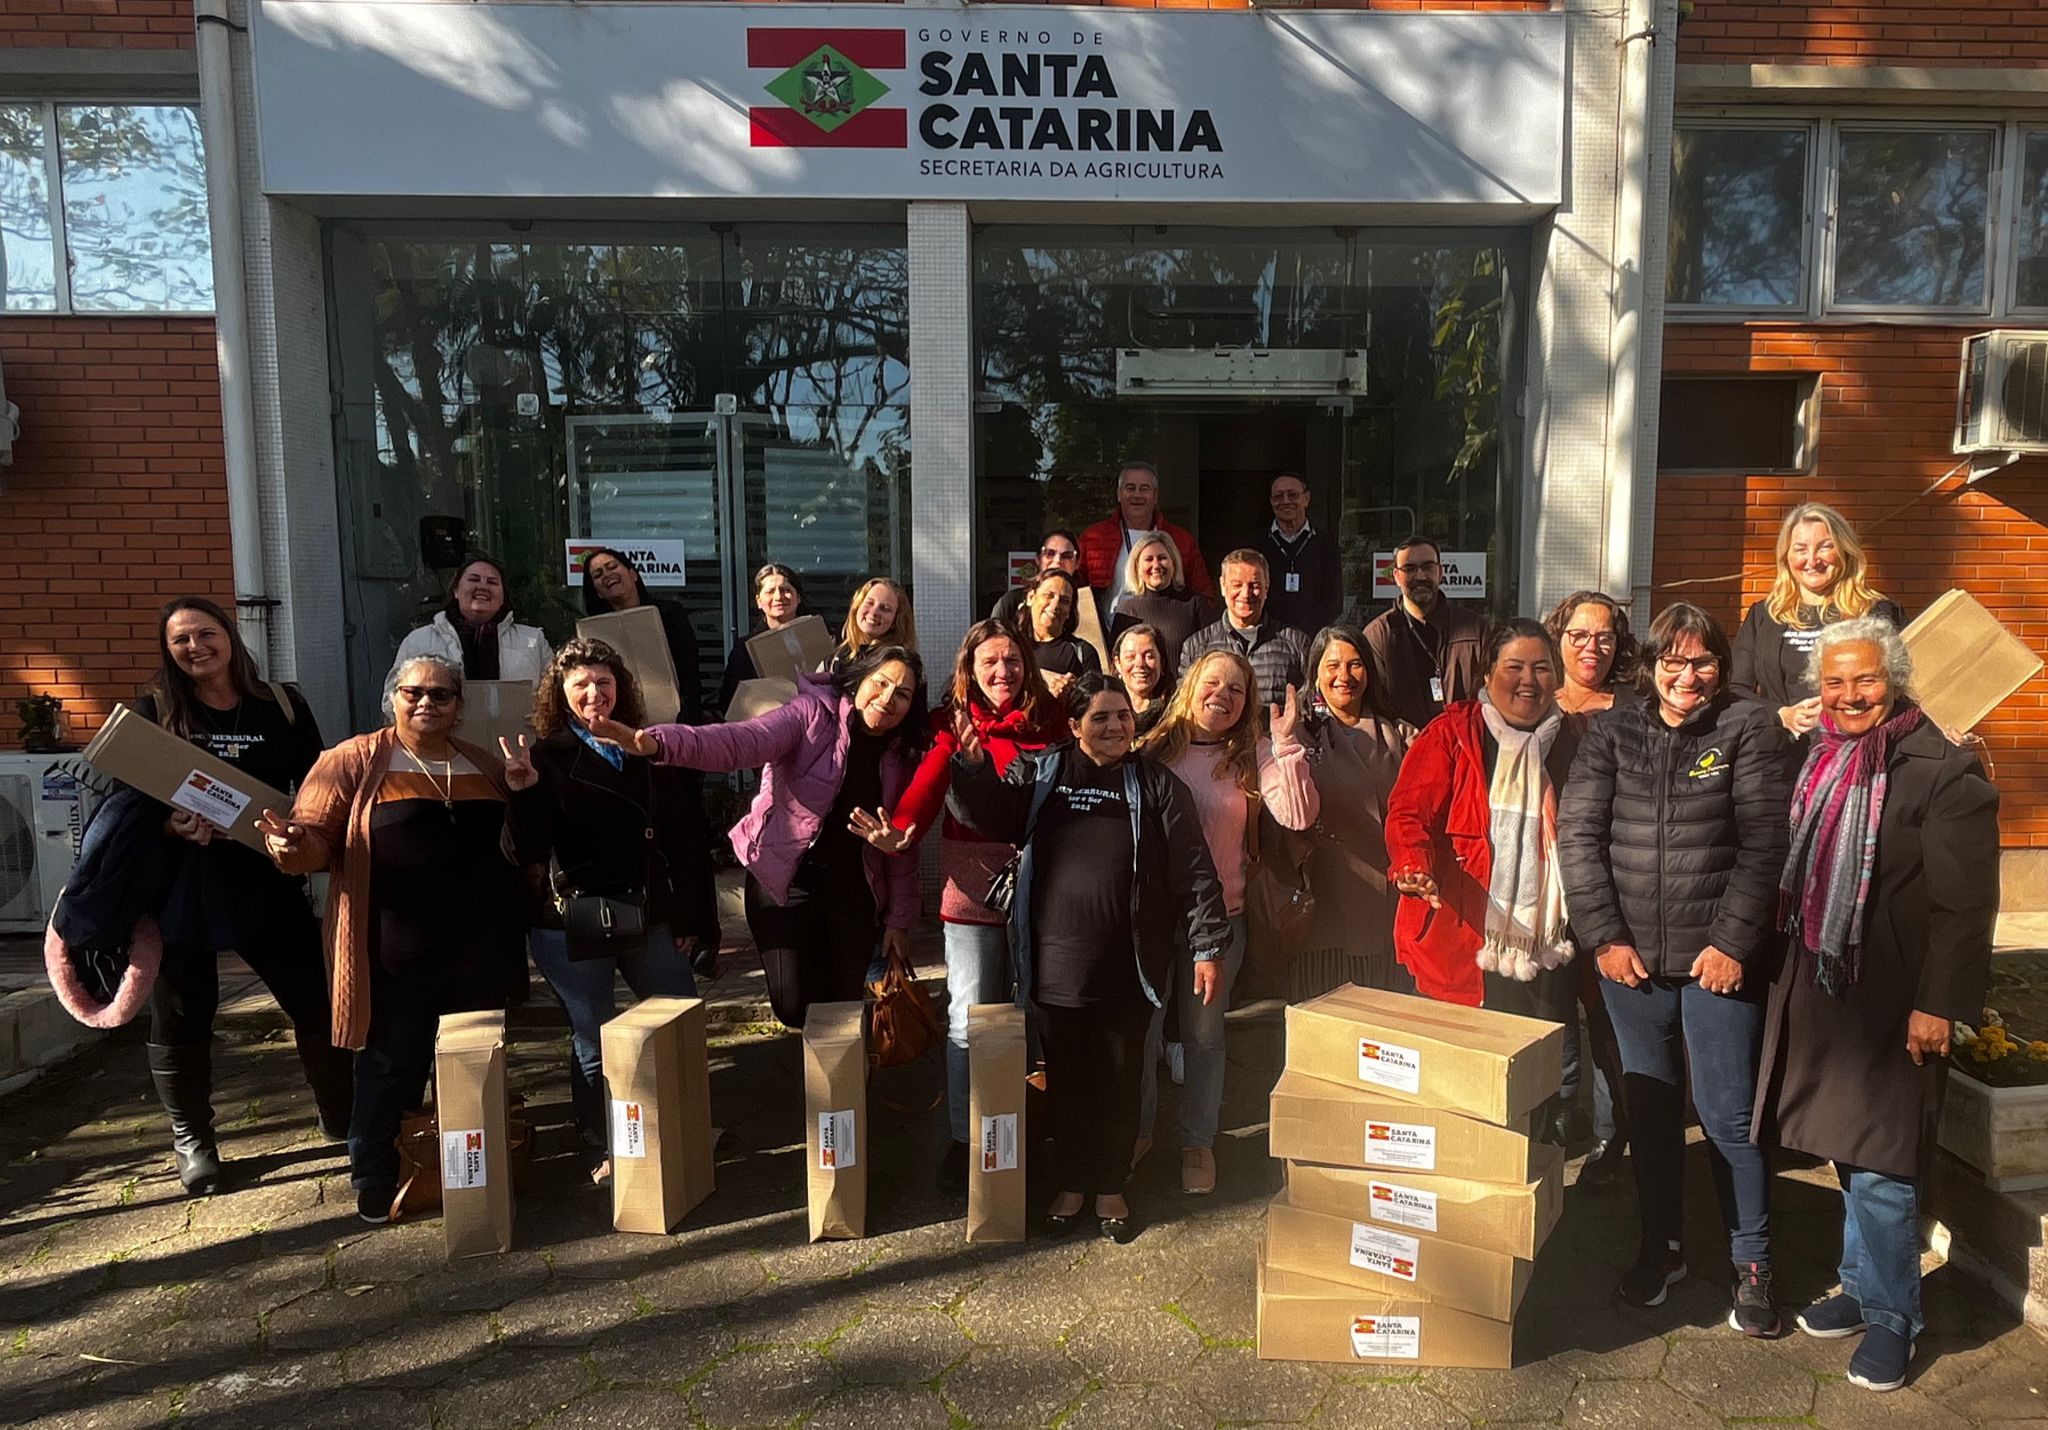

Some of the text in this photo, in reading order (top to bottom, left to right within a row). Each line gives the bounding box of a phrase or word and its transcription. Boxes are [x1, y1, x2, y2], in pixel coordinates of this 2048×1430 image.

[919, 29, 1102, 45] GOVERNO DE
[918, 50, 1119, 98] SANTA
[918, 103, 1224, 152] CATARINA
[920, 160, 1225, 179] SECRETARIA DA AGRICULTURA
[635, 563, 682, 573] ARINA
[1440, 576, 1482, 585] ARINA
[210, 784, 234, 799] SANTA
[206, 789, 241, 810] CATARINA
[1381, 1049, 1404, 1060] SANTA
[1381, 1056, 1416, 1069] CATARINA
[1391, 1129, 1417, 1137] SANTA
[1390, 1136, 1431, 1145] CATARINA
[1393, 1192, 1419, 1202] SANTA
[1393, 1198, 1433, 1210] CATARINA
[1354, 1246, 1392, 1262] CATARINA
[1366, 1257, 1391, 1268] SANTA
